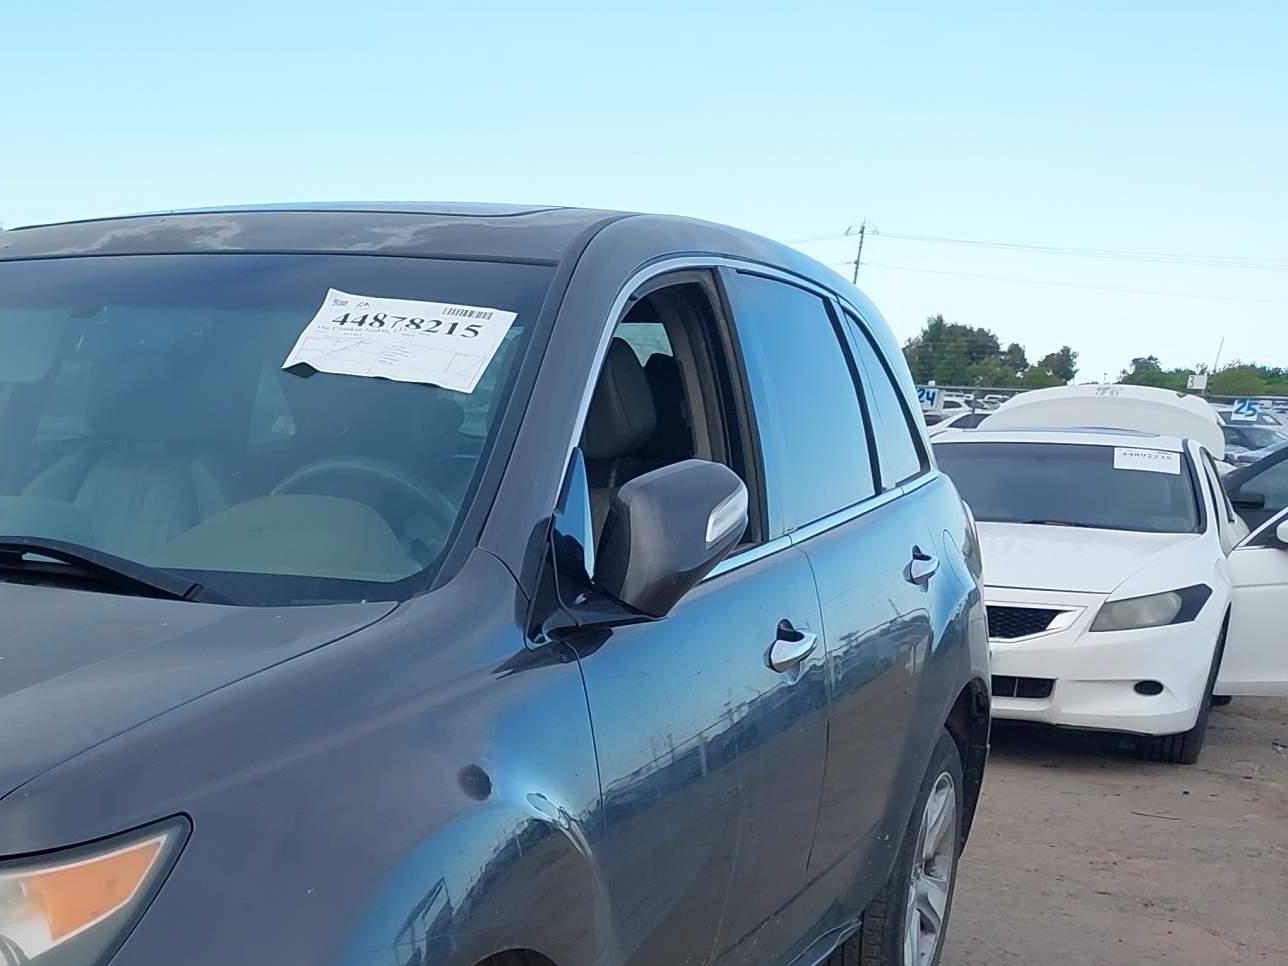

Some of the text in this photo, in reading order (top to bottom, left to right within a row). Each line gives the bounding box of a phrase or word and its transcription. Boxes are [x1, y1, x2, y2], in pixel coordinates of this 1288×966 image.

[332, 312, 484, 339] 44878215
[917, 387, 936, 407] 24
[1234, 398, 1259, 417] 25
